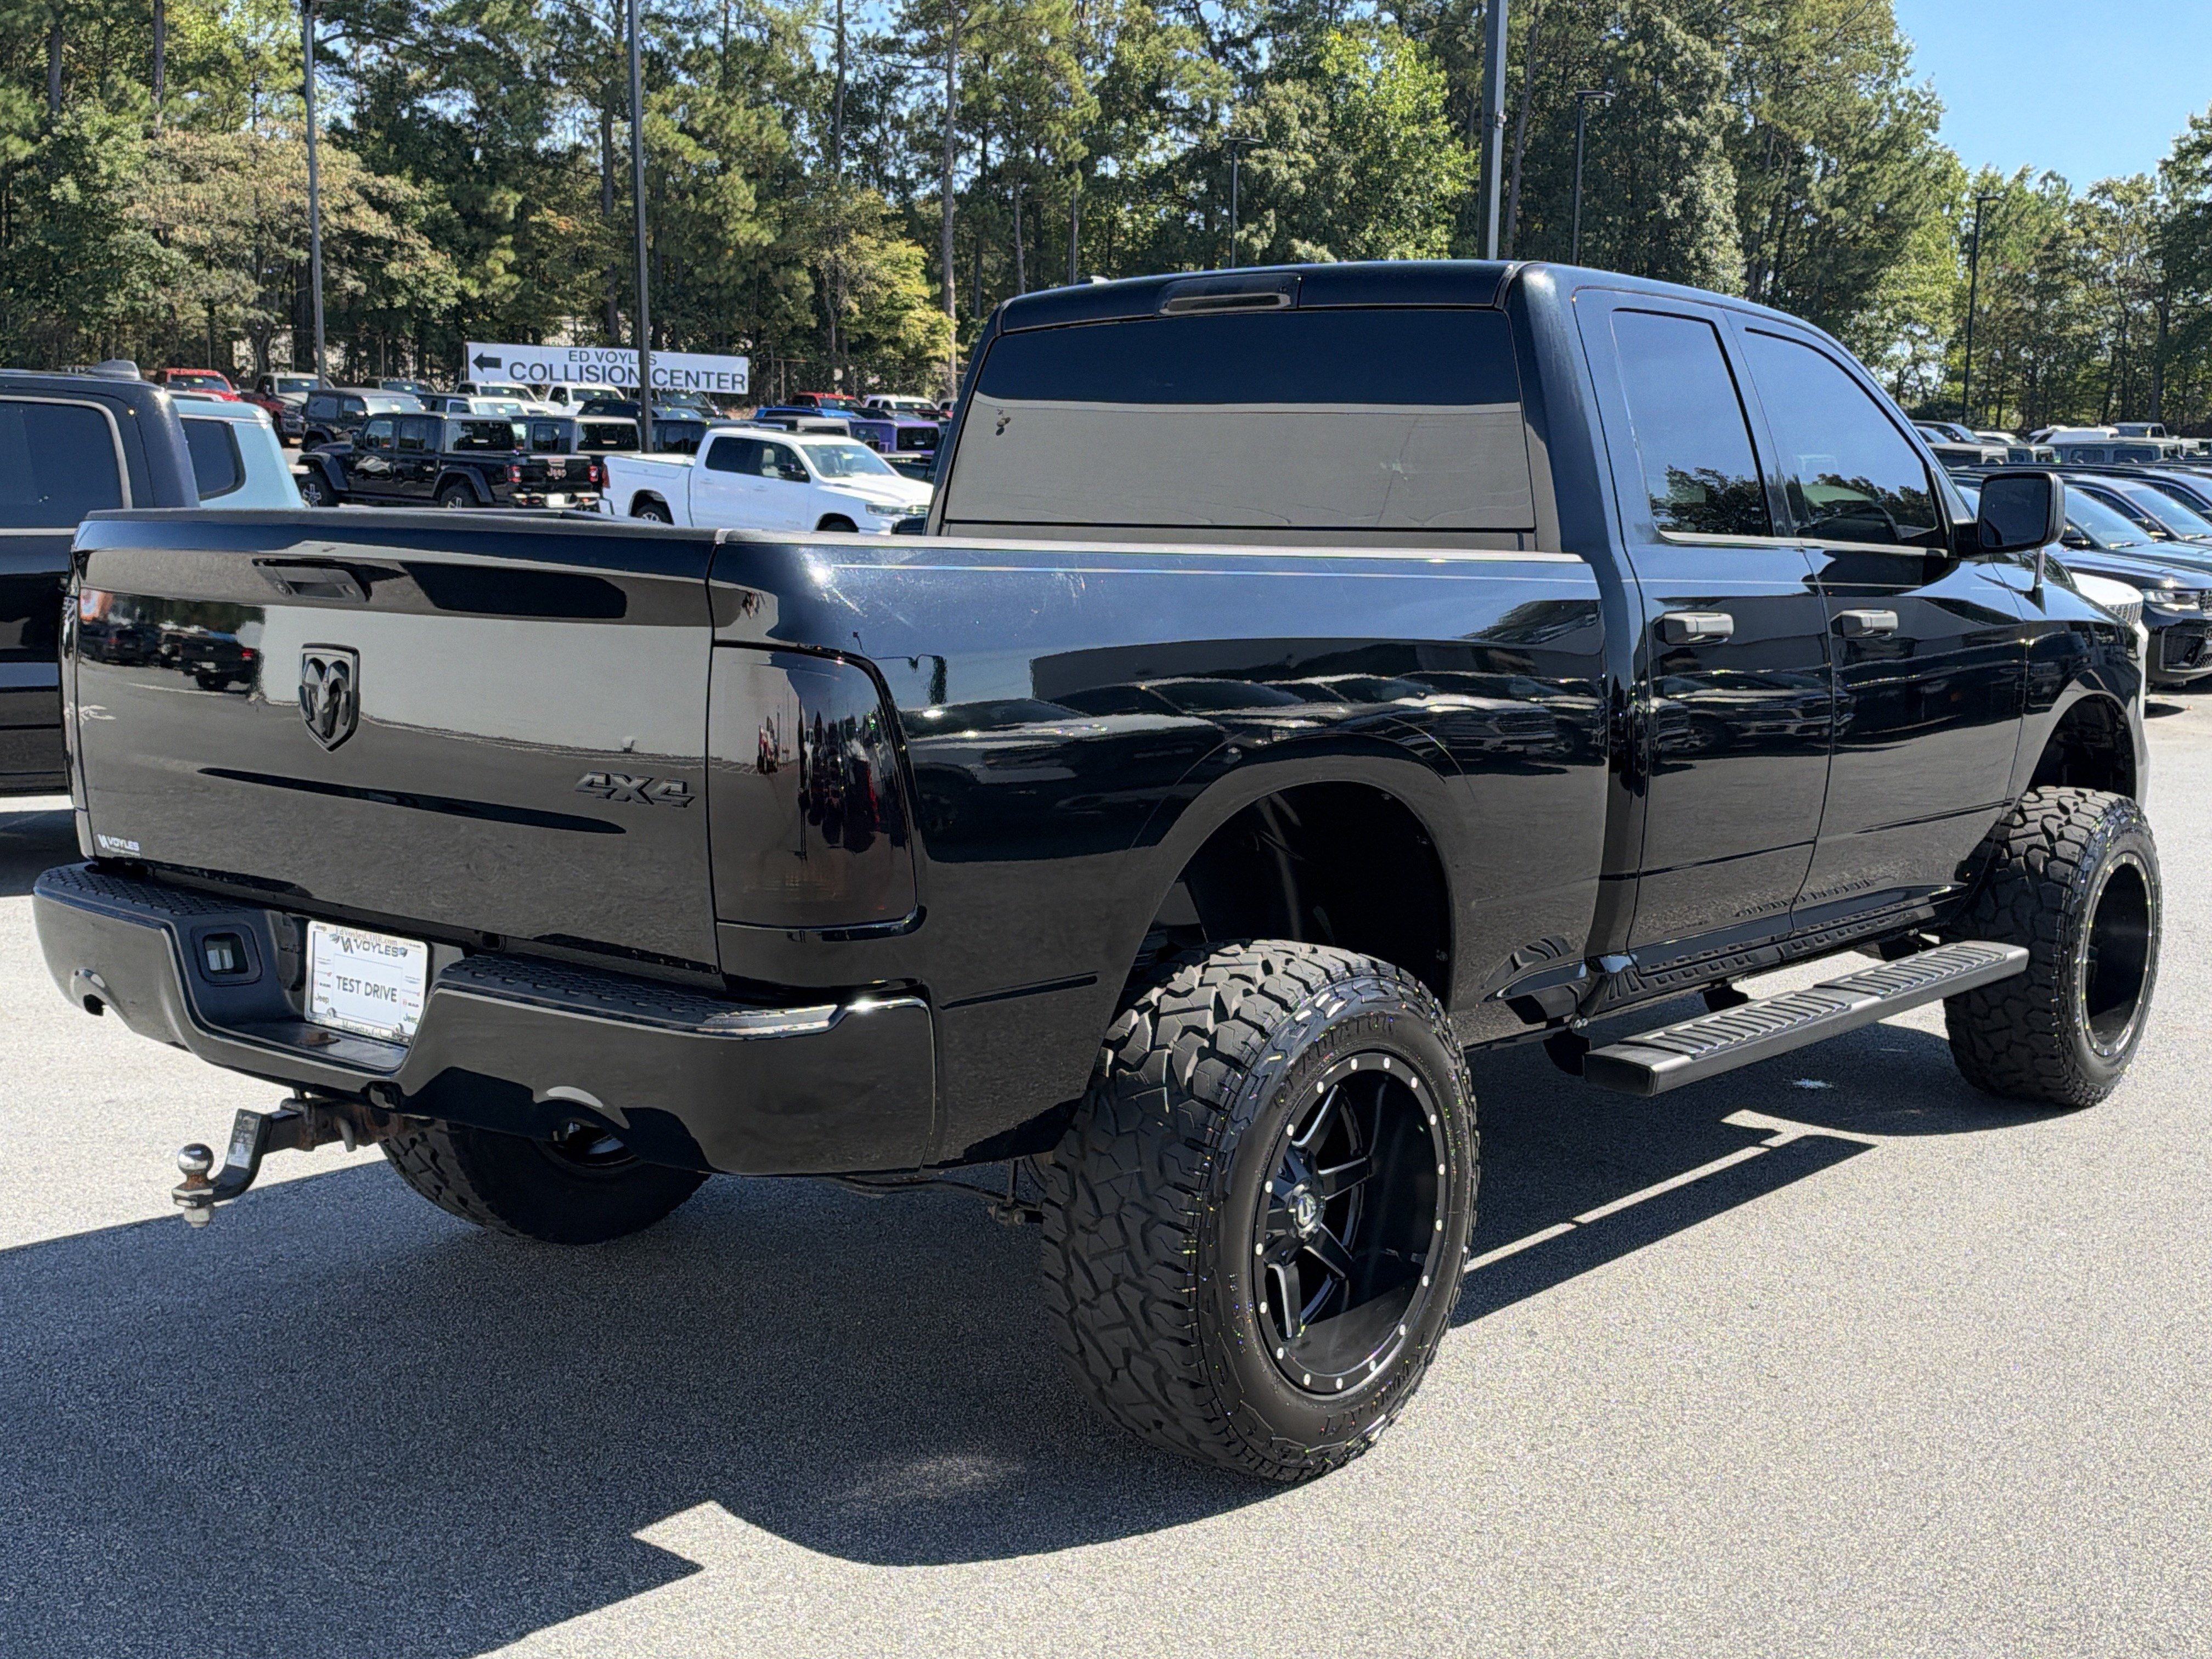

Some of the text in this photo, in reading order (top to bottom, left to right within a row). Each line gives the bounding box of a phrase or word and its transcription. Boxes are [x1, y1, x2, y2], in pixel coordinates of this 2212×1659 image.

[569, 350, 657, 365] ED VOYLS
[509, 362, 746, 391] COLLISION CENTER
[354, 939, 399, 957] VOYLES
[336, 975, 362, 994] TEST
[364, 982, 397, 1002] DRIVE
